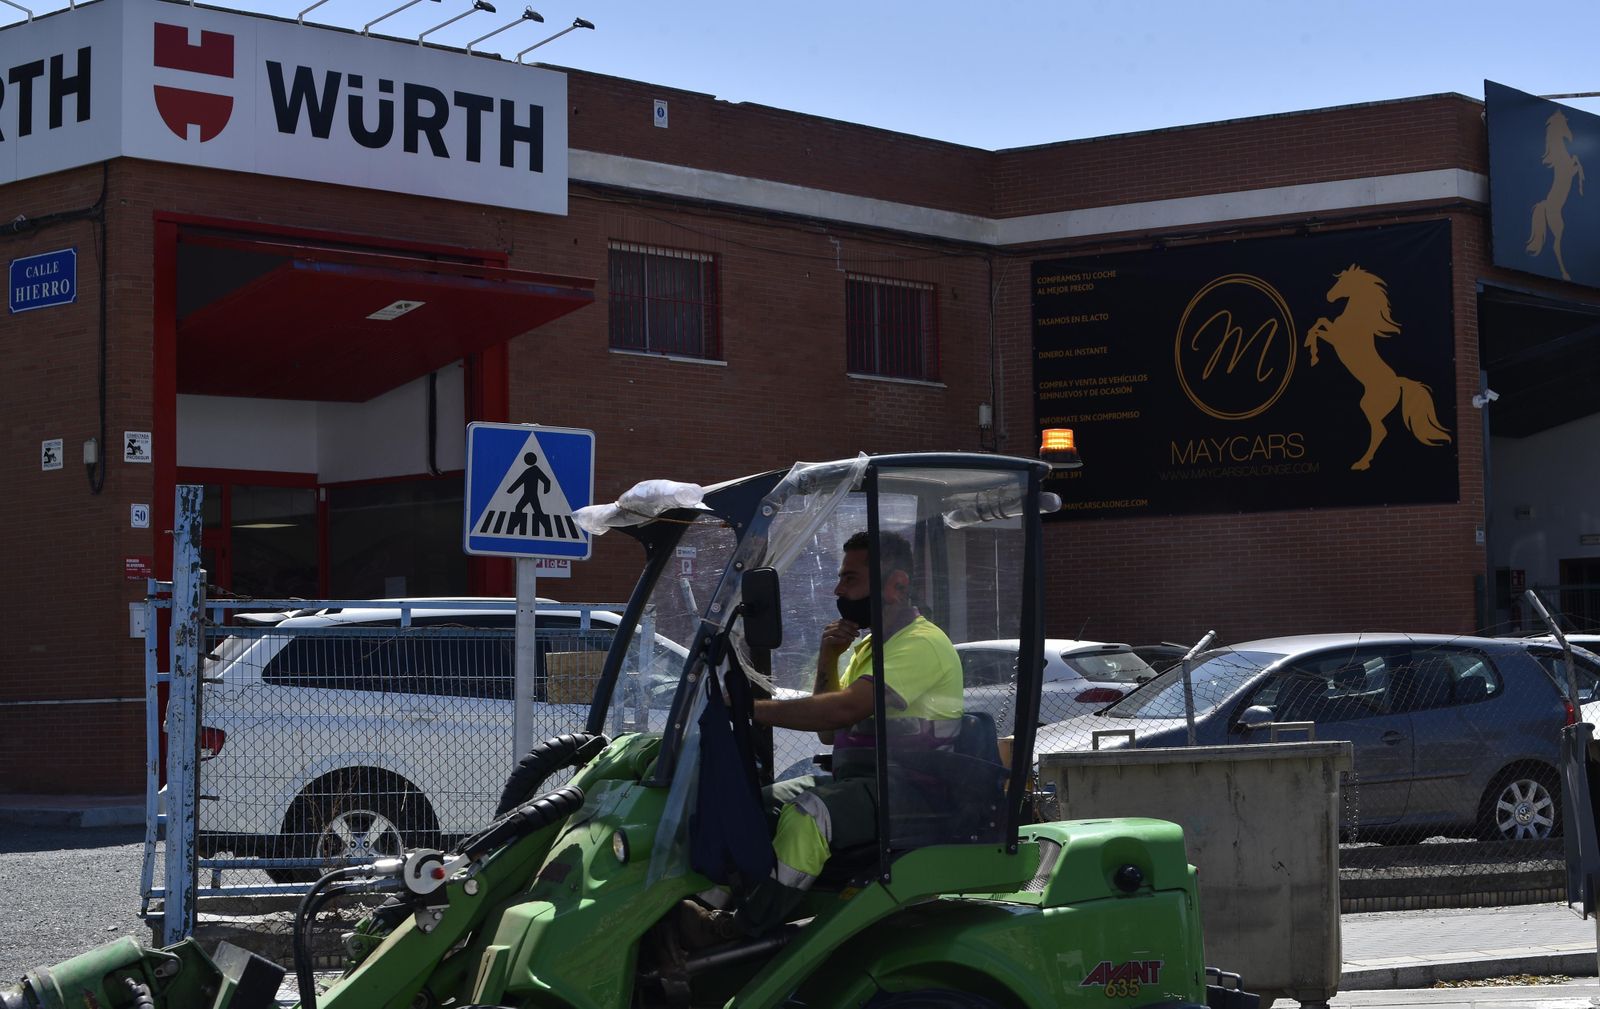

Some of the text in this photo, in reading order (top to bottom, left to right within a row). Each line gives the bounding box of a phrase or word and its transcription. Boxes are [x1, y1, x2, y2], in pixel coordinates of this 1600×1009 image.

[0, 46, 91, 142] TH
[266, 60, 544, 173] WÜRTH
[26, 261, 59, 279] CALLE
[1037, 270, 1117, 285] COMPRAMOS TU COCHE
[16, 278, 70, 303] HIERRO
[1038, 283, 1095, 295] AL MEJOR PRECIO
[1039, 312, 1109, 326] TASAMOS EN EL ACTO
[1038, 346, 1108, 359] DINERO AL INSTANTE
[1039, 379, 1067, 389] COMPRA
[1074, 377, 1098, 387] VENTA
[1098, 376, 1107, 385] DE
[1039, 389, 1083, 400] SEMINUEVOS
[1089, 388, 1099, 396] DE
[1099, 384, 1133, 395] OCASIÓN
[1080, 414, 1092, 423] SIN
[1092, 410, 1140, 421] COMPROMISO
[1171, 432, 1305, 465] MAYCARS
[1062, 499, 1149, 511] MAYCARSCALONGE.COM
[134, 510, 147, 522] 50
[1078, 960, 1165, 987] AVANT
[1105, 979, 1140, 998] 635
